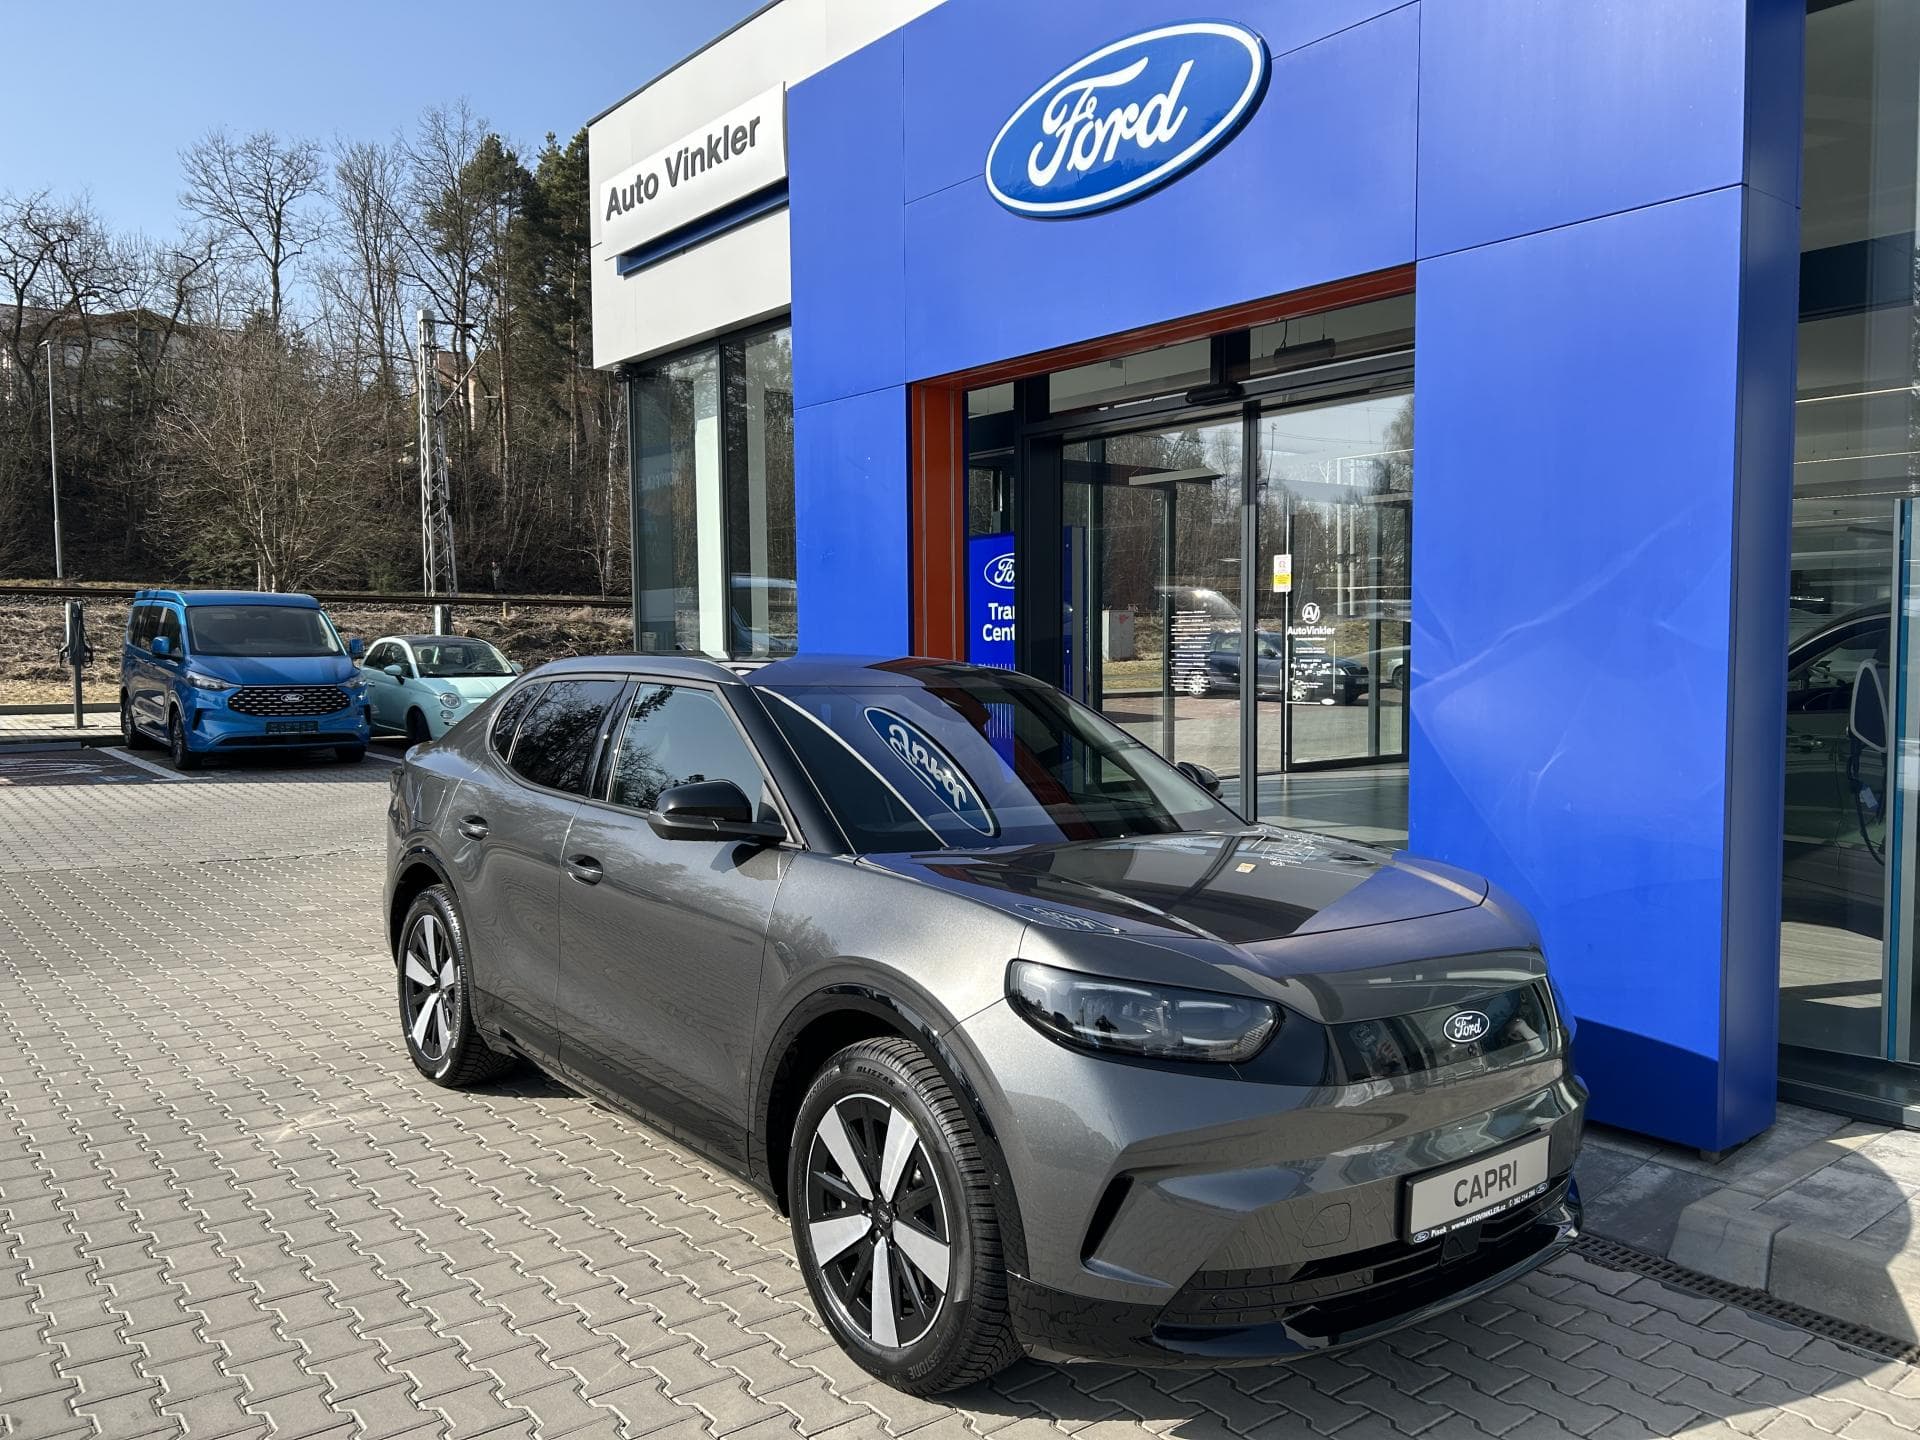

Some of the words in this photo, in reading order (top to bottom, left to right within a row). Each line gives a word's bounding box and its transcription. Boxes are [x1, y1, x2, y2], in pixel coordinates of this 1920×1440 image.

[1027, 56, 1195, 187] Ford
[606, 172, 659, 221] Auto
[665, 116, 761, 188] Vinkler
[994, 558, 1015, 584] Fo
[1454, 1014, 1482, 1039] Ford
[856, 1066, 896, 1088] BLIZZAK
[1453, 1160, 1518, 1207] CAPRI
